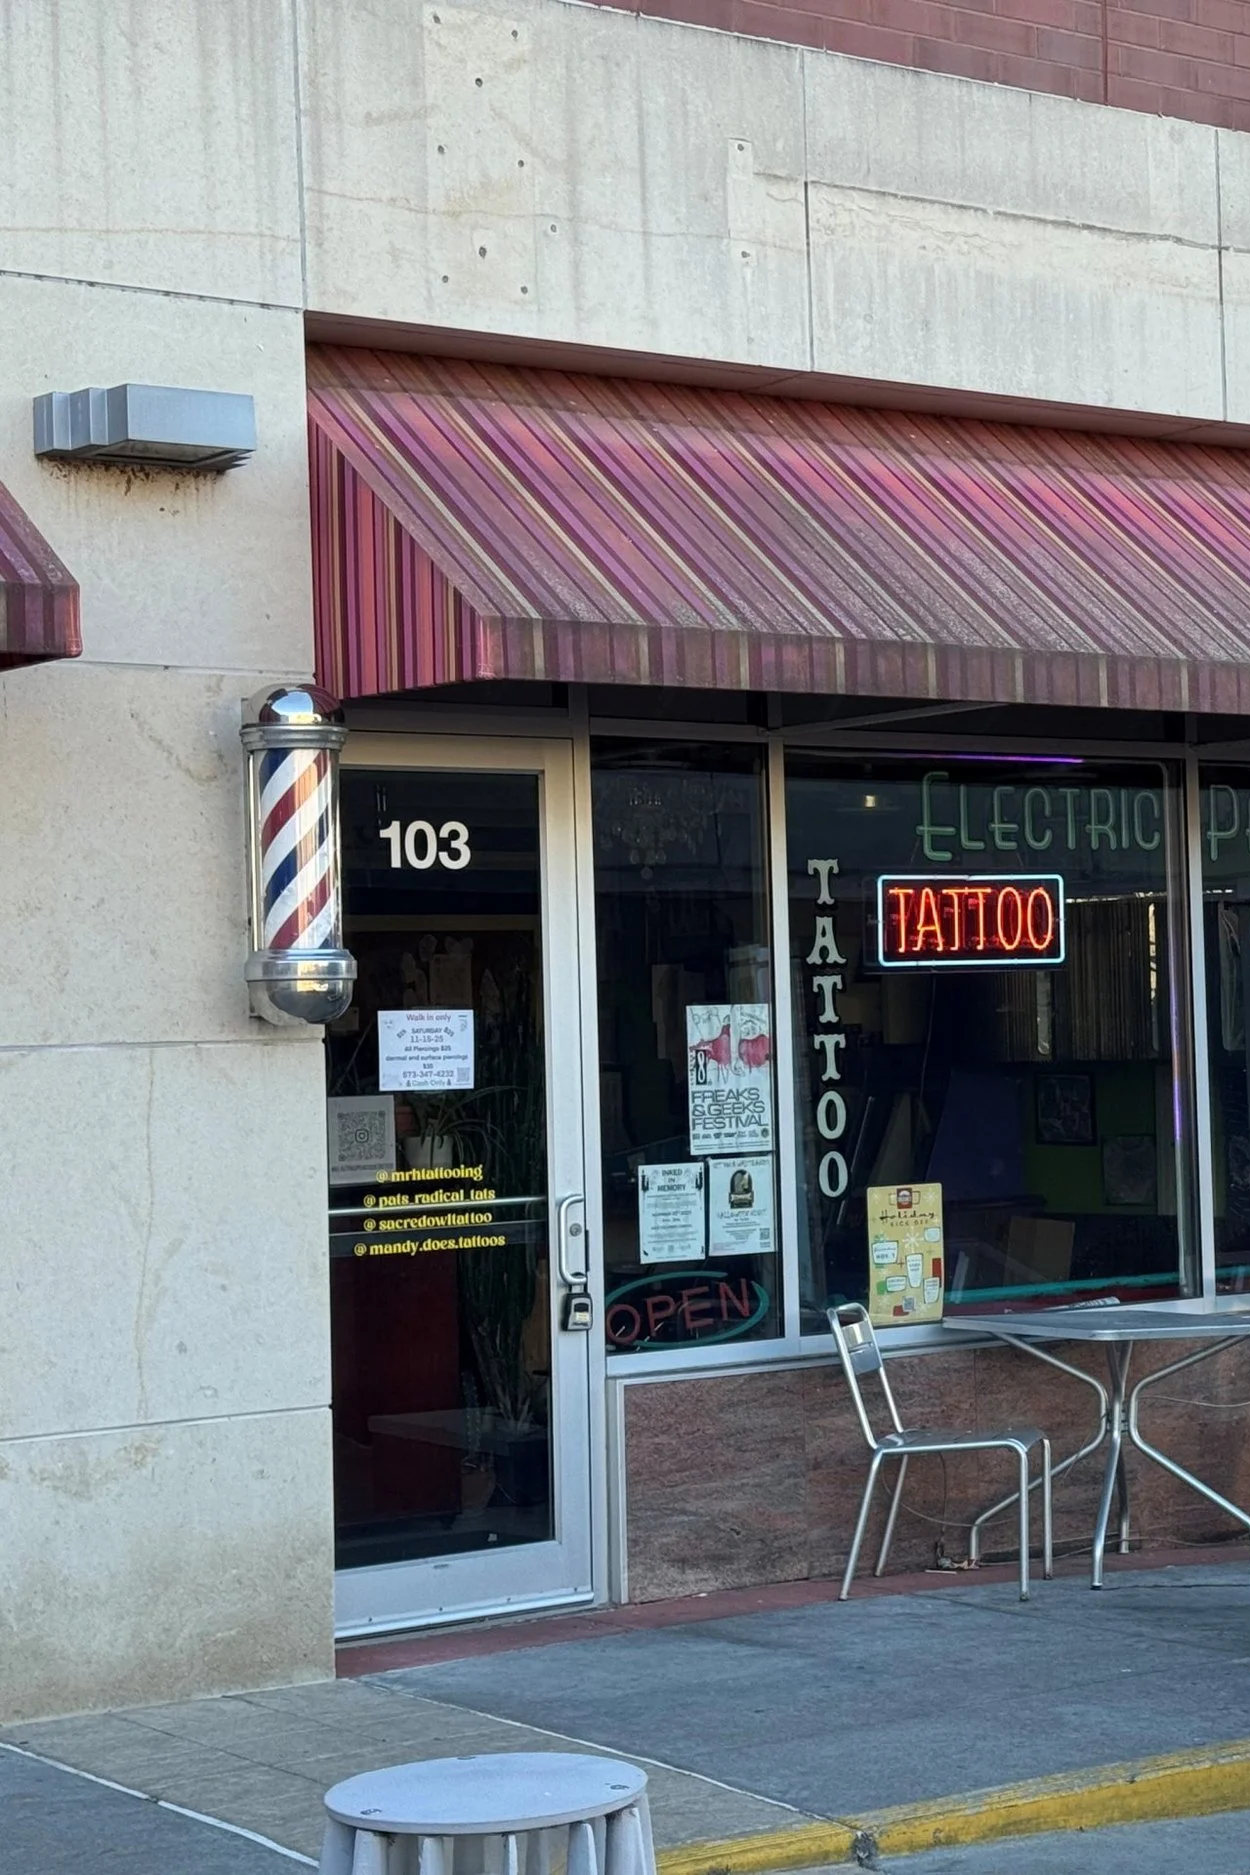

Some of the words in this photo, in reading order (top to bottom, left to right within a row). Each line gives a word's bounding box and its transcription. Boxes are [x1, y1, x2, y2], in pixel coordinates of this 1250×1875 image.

[915, 771, 1161, 861] ELECTRIC
[379, 820, 471, 870] 103
[889, 887, 1053, 953] TATTOO
[435, 1014, 451, 1022] only
[806, 858, 849, 1198] TATTOO
[691, 1087, 760, 1104] FREAKS
[692, 1104, 706, 1117] &
[707, 1101, 765, 1117] GEEKS
[692, 1114, 769, 1131] FESTIVAL
[369, 1234, 506, 1256] mandy.does.tattoos
[606, 1278, 751, 1344] OPEN
